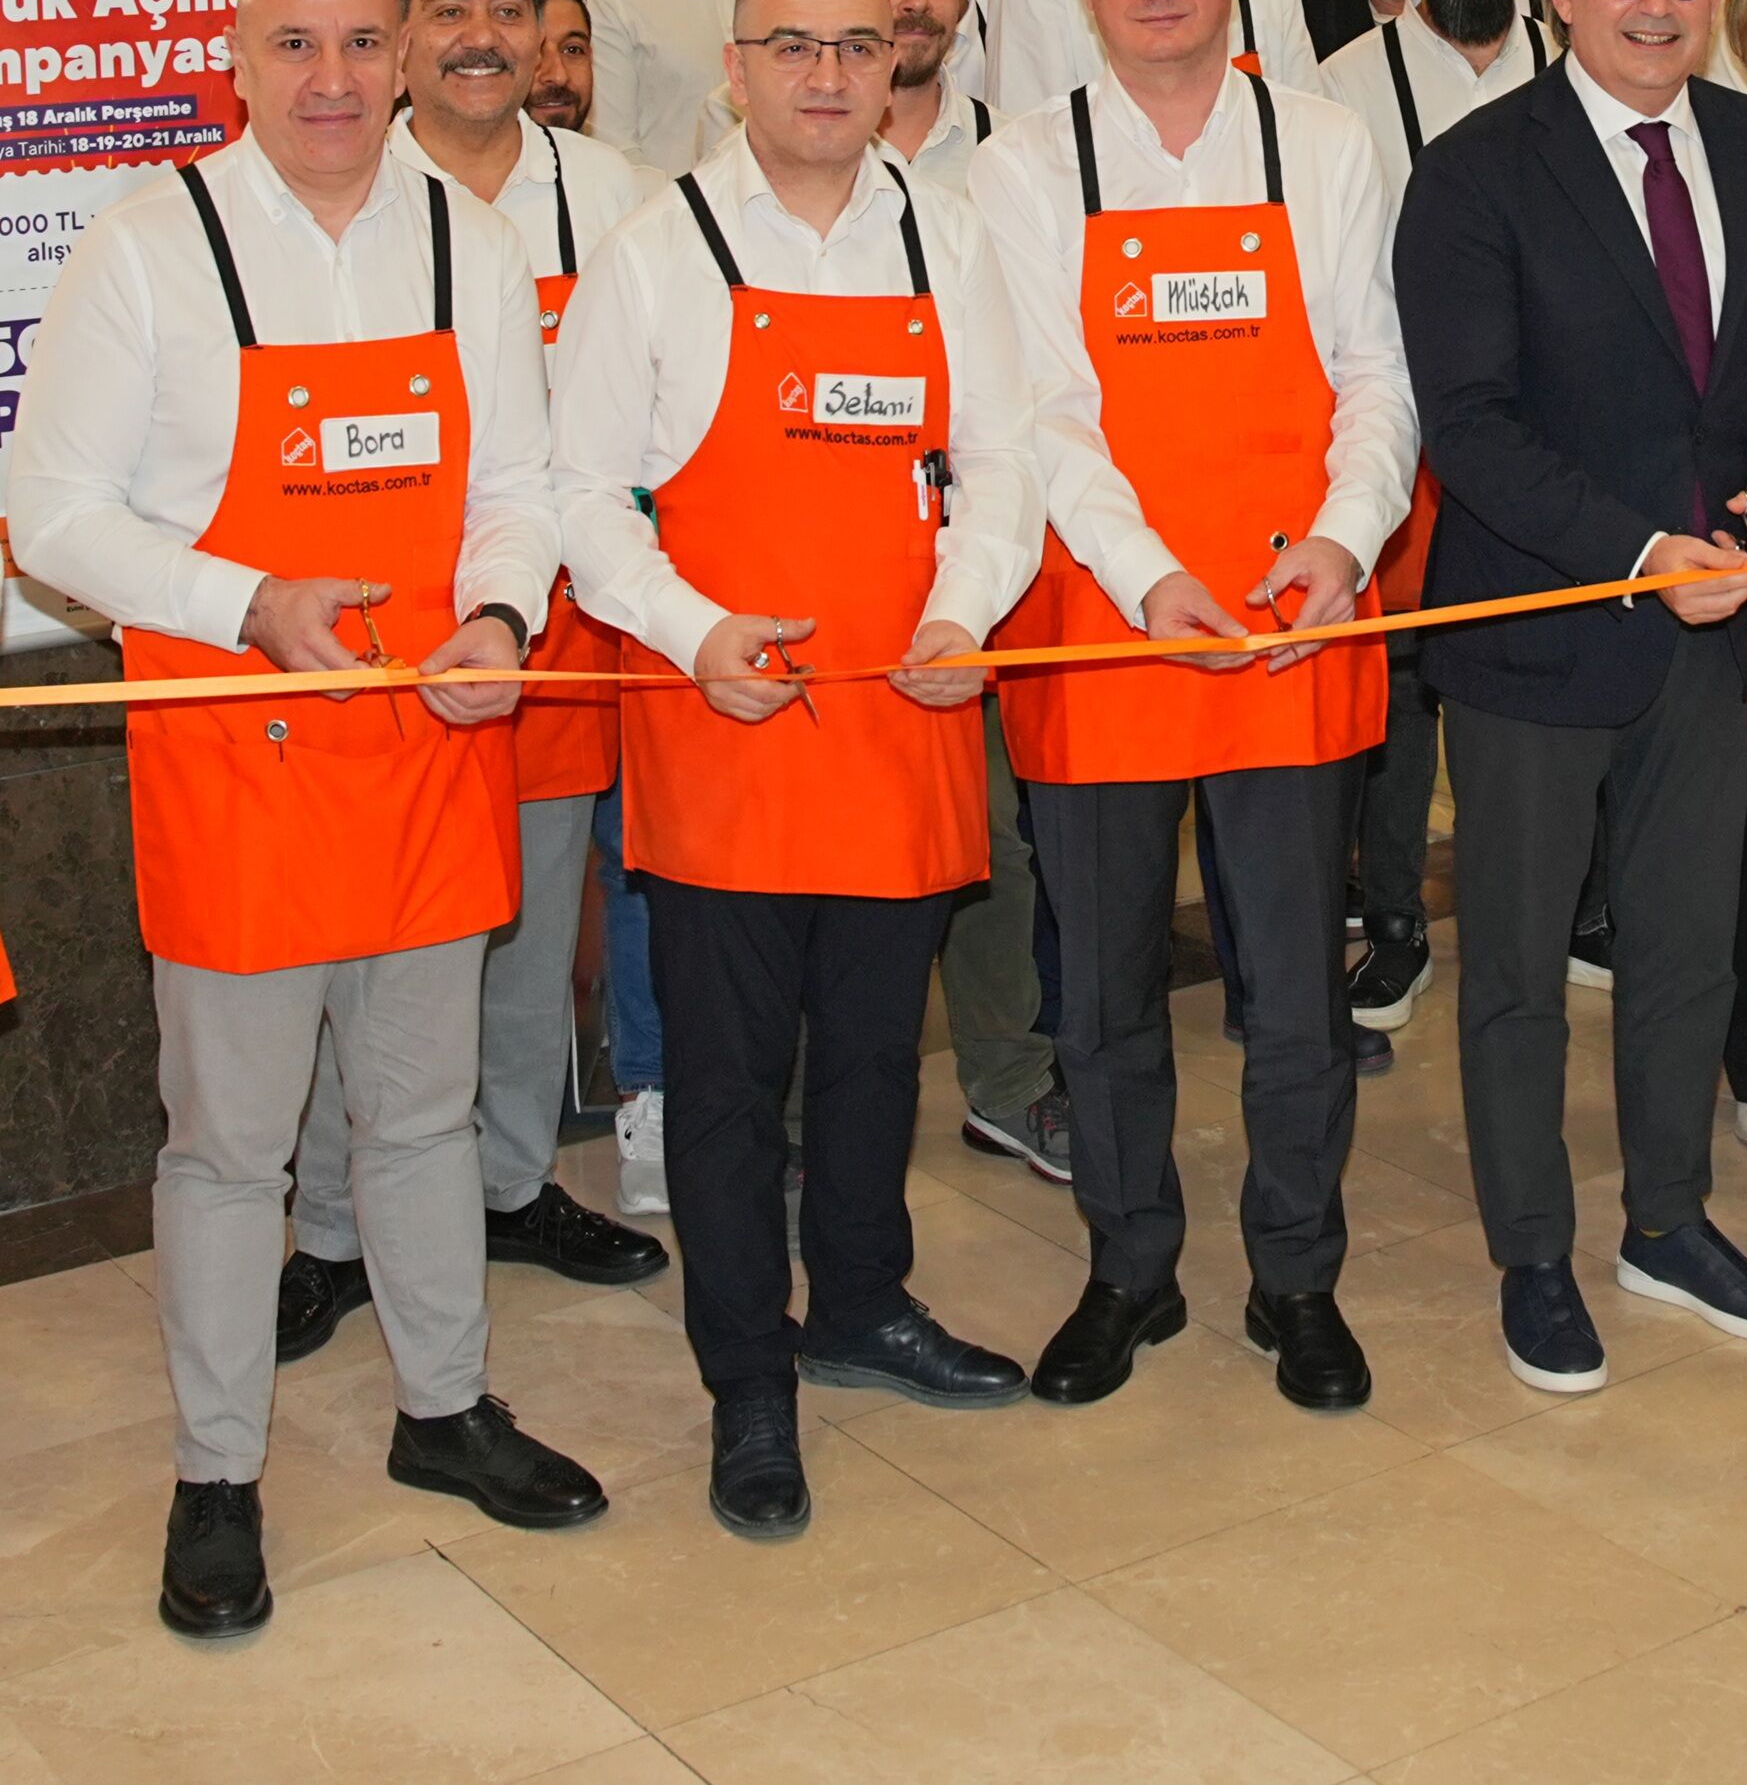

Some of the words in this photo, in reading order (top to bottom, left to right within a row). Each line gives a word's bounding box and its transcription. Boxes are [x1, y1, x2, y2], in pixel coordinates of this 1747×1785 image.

[17, 111, 38, 126] 18
[43, 106, 97, 126] Aralık
[102, 101, 192, 124] Perşembe
[20, 140, 66, 157] Tarihi:
[70, 134, 170, 152] 18-19-20-21
[174, 128, 222, 144] Aralık
[56, 212, 84, 231] TL
[1168, 275, 1249, 315] Müştak
[1116, 324, 1261, 345] www.koctas.com.tr
[785, 427, 918, 446] www.koctas.com.tr
[282, 472, 432, 496] www.koctas.com.tr
